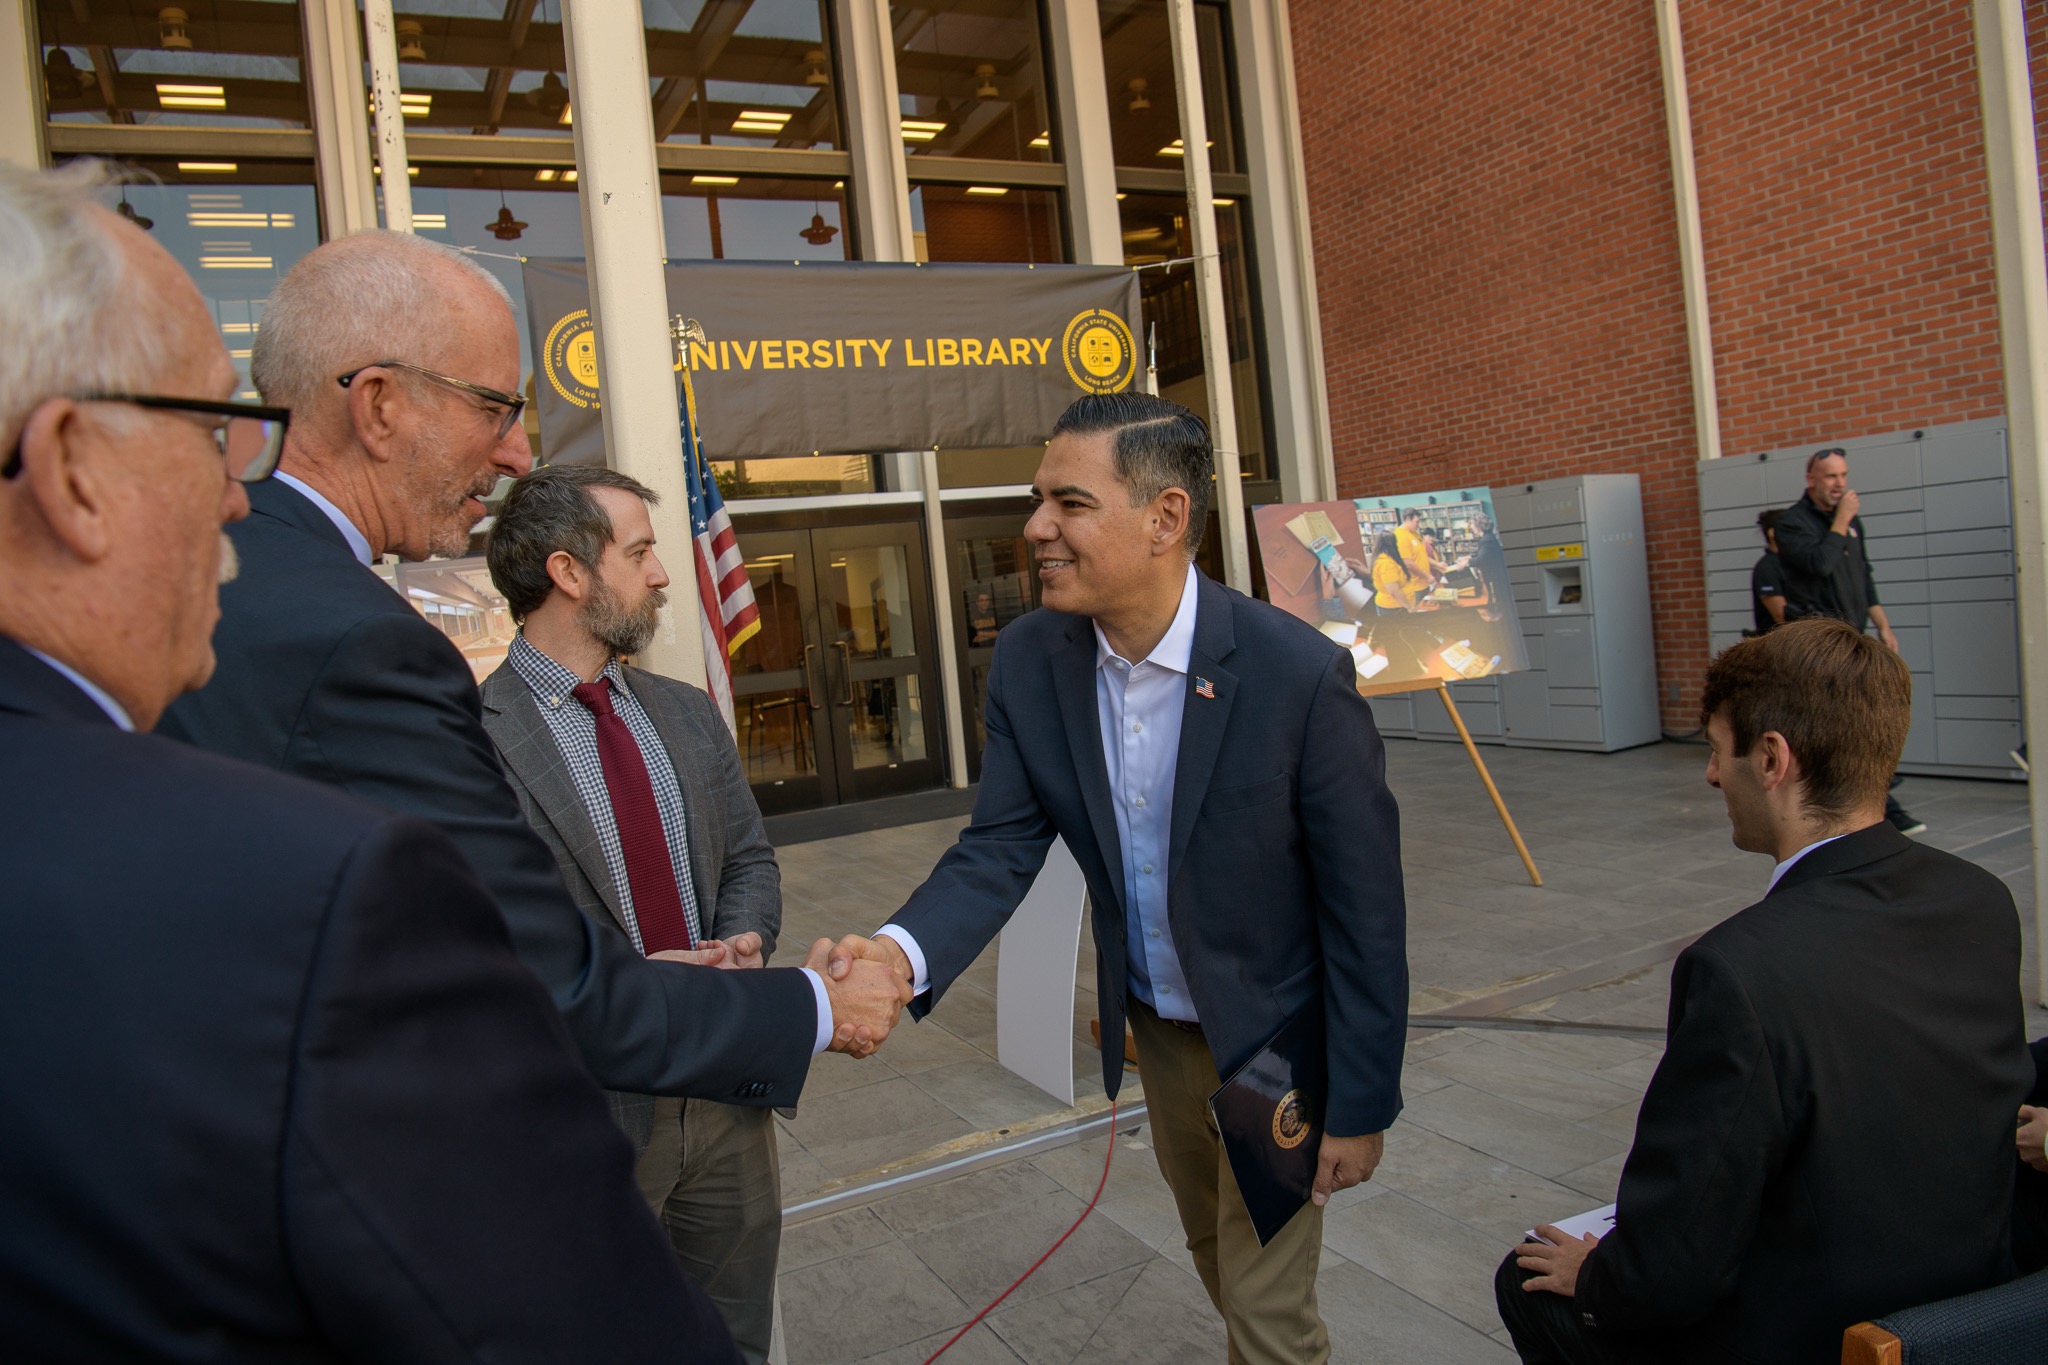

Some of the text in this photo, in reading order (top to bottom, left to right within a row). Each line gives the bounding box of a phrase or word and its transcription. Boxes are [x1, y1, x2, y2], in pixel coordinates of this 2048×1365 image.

[555, 324, 579, 367] CALIFORNIA
[906, 338, 1053, 366] LIBRARY
[1071, 322, 1088, 358] CALIFORNIA
[1108, 323, 1128, 358] UNIVERSITY
[574, 387, 596, 399] LONG
[1084, 374, 1121, 386] LONG BEACH
[1274, 1101, 1298, 1145] UNITED STATES
